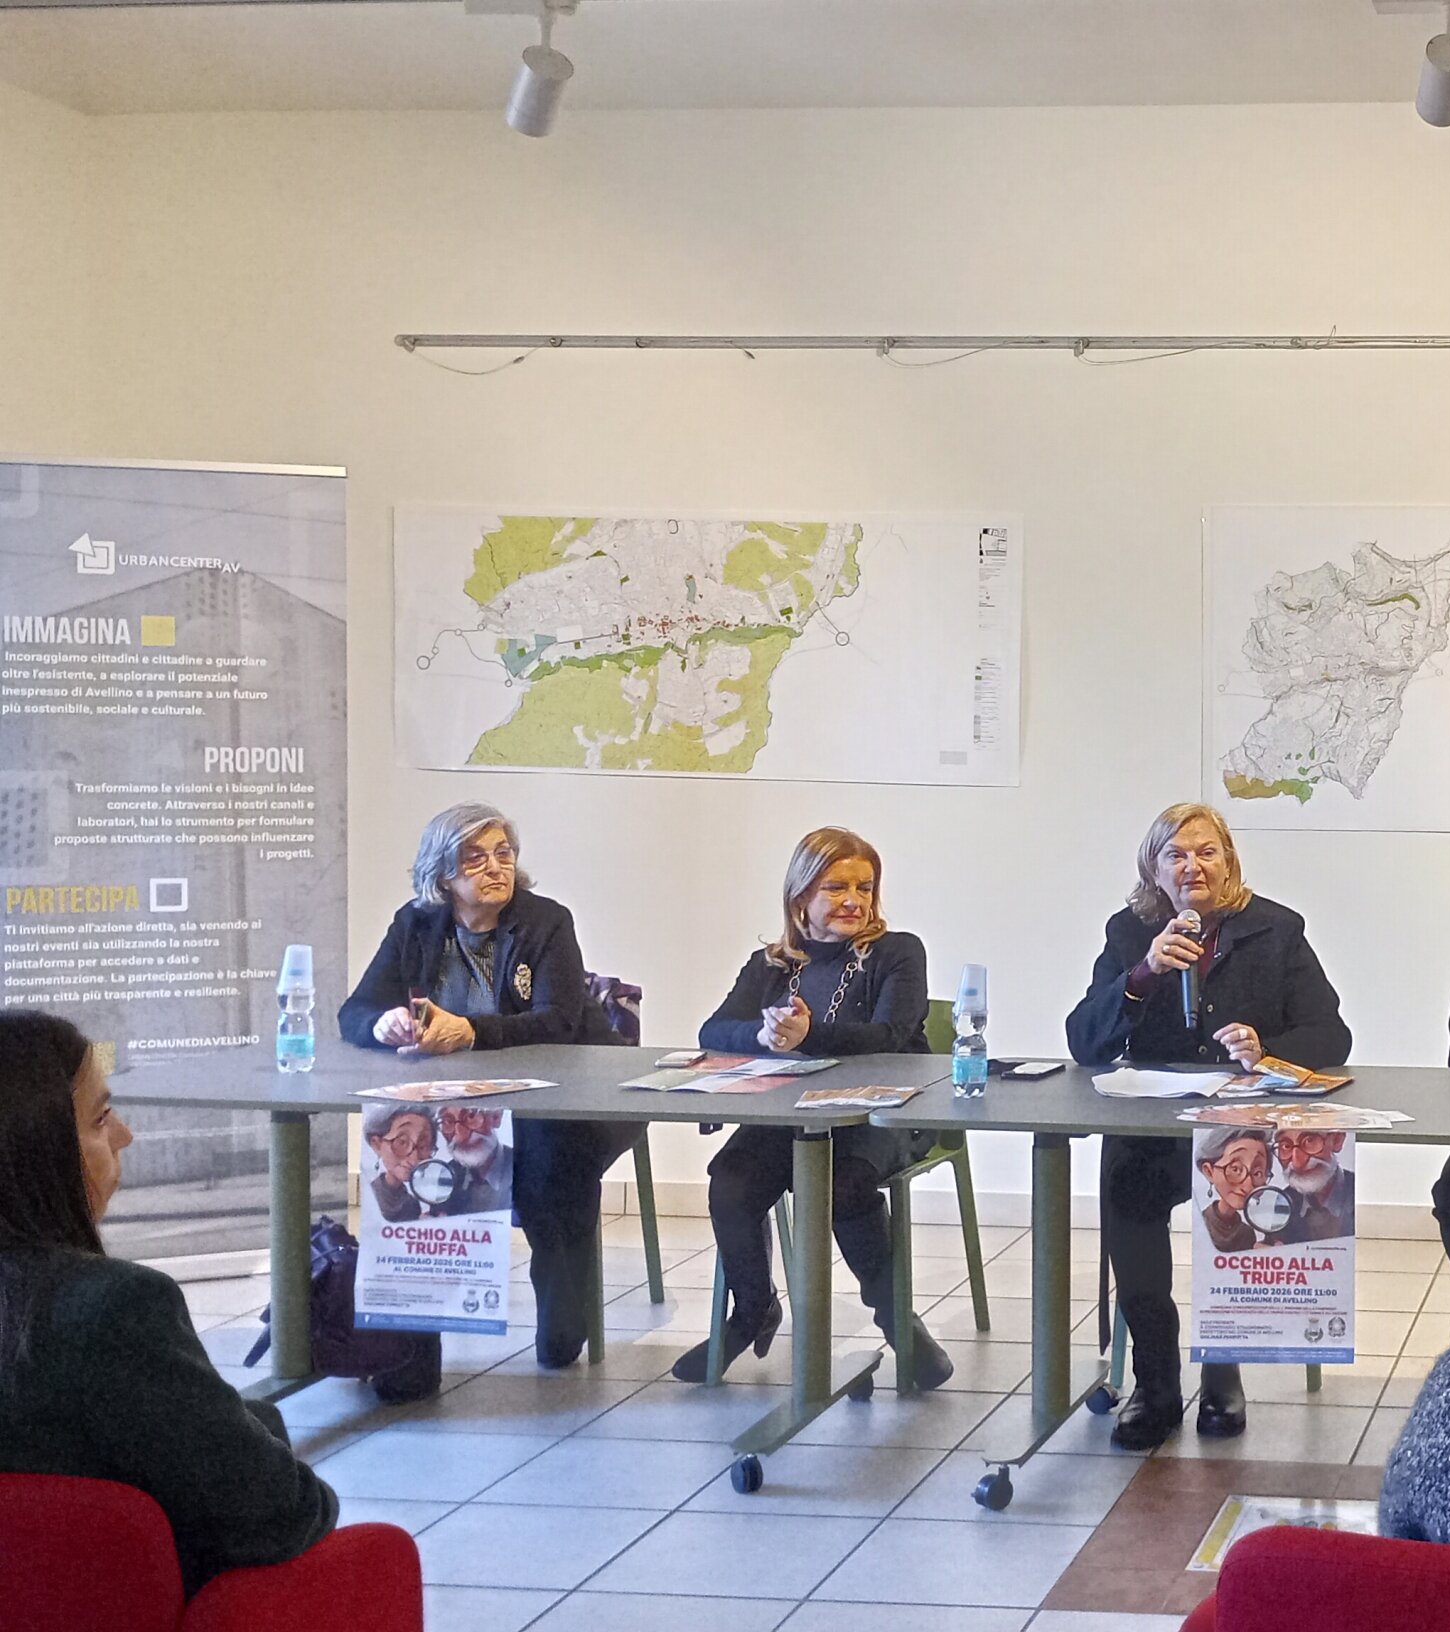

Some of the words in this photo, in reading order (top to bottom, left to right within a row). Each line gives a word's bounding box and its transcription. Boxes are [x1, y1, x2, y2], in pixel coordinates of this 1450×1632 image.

[118, 554, 222, 568] URBANCENTER
[221, 563, 241, 573] AV
[3, 615, 131, 645] IMMAGINA
[5, 651, 88, 664] Incoraggiamo
[91, 653, 139, 664] cittadini
[142, 655, 149, 664] e
[152, 654, 203, 665] cittadine
[205, 657, 213, 666] a
[216, 656, 267, 668] guardare
[2, 703, 21, 714] più
[24, 704, 93, 714] sostenibile,
[96, 704, 138, 714] sociale
[152, 705, 206, 715] culturale.
[204, 747, 304, 773] PROPONI
[75, 783, 158, 793] Trasformiamo
[161, 783, 171, 793] le
[175, 783, 212, 793] visioni
[215, 785, 223, 793] e
[232, 783, 273, 795] bisogni
[277, 783, 287, 793] in
[290, 783, 314, 793] idee
[107, 801, 161, 810] concrete.
[165, 800, 225, 810] Attraverso
[235, 800, 267, 809] nostri
[270, 800, 304, 810] canali
[307, 802, 315, 810] e
[54, 834, 107, 846] proposte
[110, 834, 172, 843] strutturate
[175, 832, 196, 843] che
[199, 834, 248, 845] possono
[251, 832, 314, 842] influenzare
[267, 848, 314, 860] progetti.
[5, 884, 139, 914] PARTECIPA
[4, 924, 16, 934] Ti
[19, 924, 75, 934] invitiamo
[78, 922, 133, 933] all'azione
[136, 921, 177, 932] diretta,
[180, 921, 197, 931] sia
[200, 919, 248, 930] venendo
[251, 919, 261, 929] ai
[4, 975, 107, 986] documentazione.
[111, 973, 125, 982] La
[128, 971, 214, 984] partecipazione
[217, 969, 224, 979] è
[227, 969, 237, 978] la
[240, 968, 277, 978] chiave
[127, 1035, 260, 1049] #COMUNEDIAVELLINO
[381, 1226, 446, 1241] OCCHIO
[450, 1229, 492, 1243] ALLA
[405, 1241, 467, 1257] TRUFFA
[1214, 1255, 1284, 1270] OCCHIO
[1288, 1257, 1334, 1271] ALLA
[1240, 1271, 1307, 1285] TRUFFA
[1210, 1287, 1221, 1295] 24
[1223, 1287, 1269, 1295] FEBBRAIO
[1271, 1288, 1291, 1296] 2026
[1294, 1288, 1312, 1296] ORE
